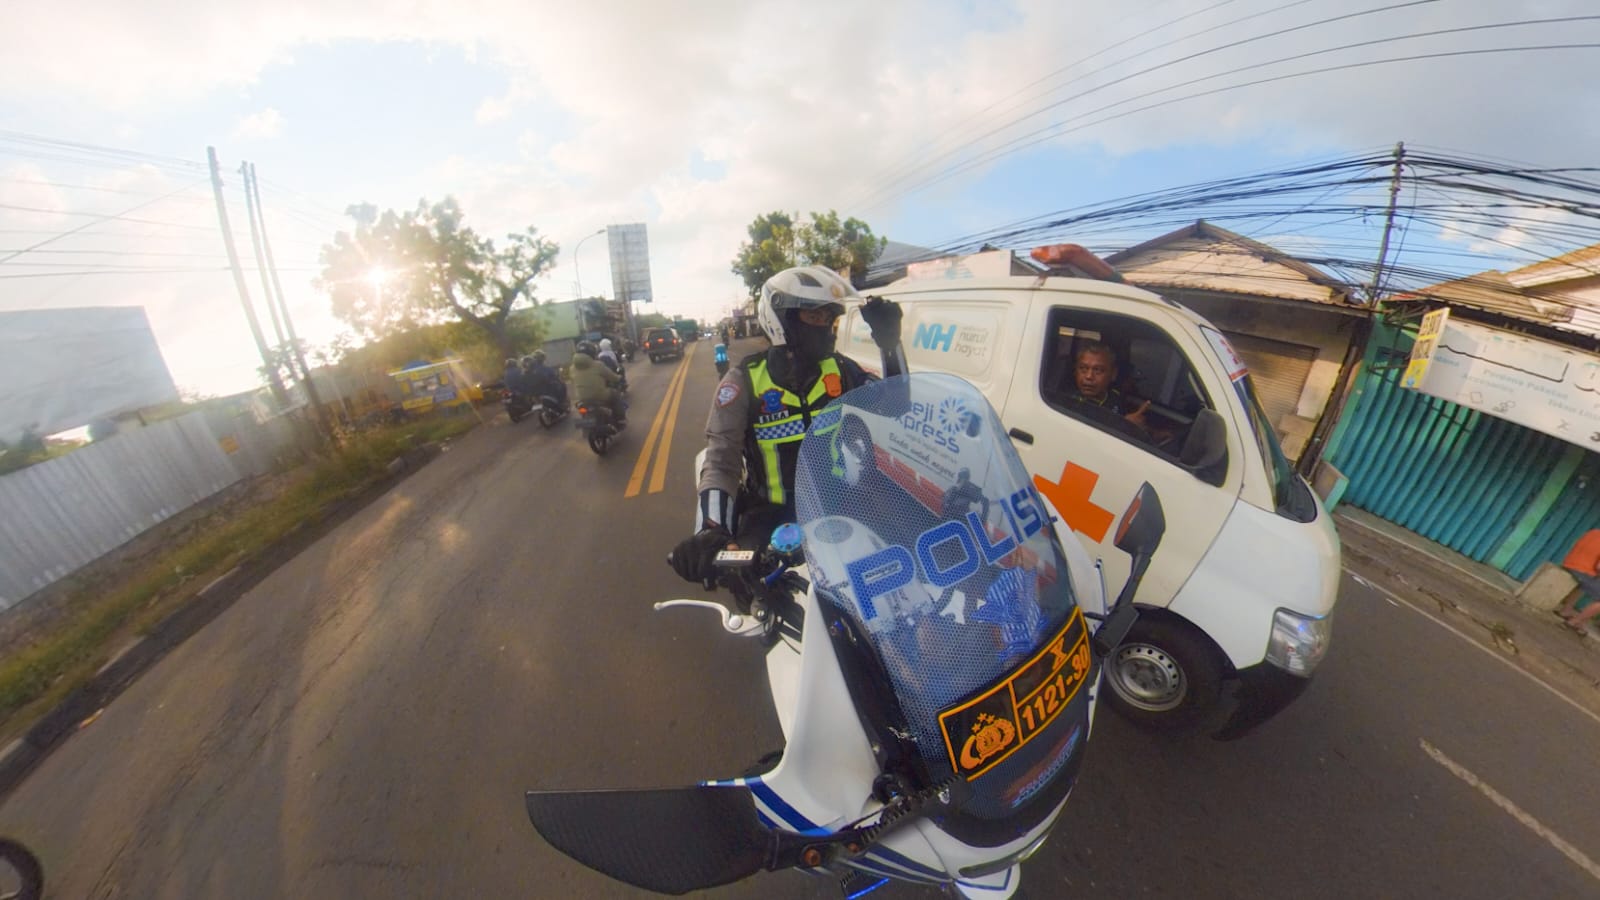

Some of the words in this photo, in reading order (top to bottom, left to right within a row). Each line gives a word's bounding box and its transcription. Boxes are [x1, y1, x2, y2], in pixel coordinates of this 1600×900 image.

[912, 322, 957, 352] NH
[912, 402, 934, 423] eji
[894, 414, 960, 454] xpress
